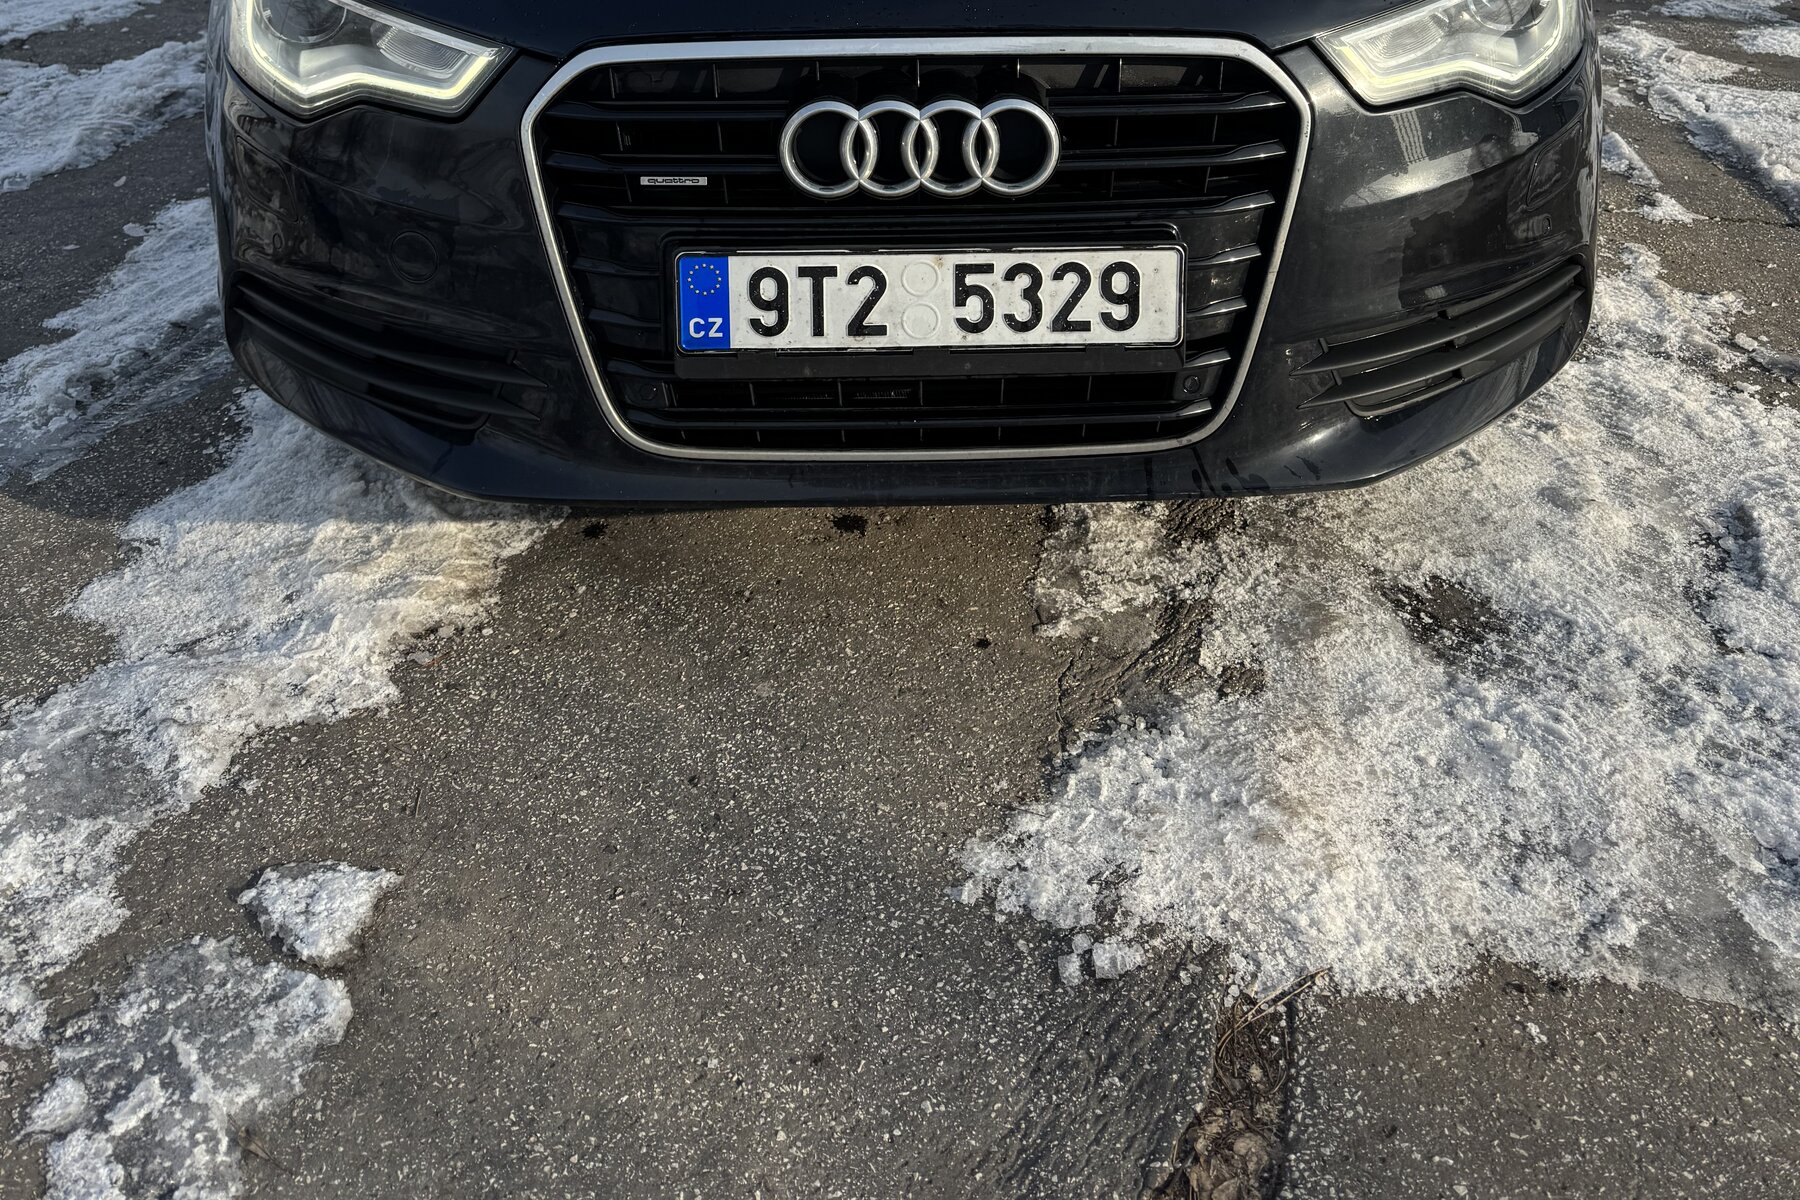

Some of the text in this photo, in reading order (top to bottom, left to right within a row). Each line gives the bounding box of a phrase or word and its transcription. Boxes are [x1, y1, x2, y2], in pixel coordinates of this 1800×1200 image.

[647, 177, 700, 185] quattro
[749, 261, 1141, 338] 9T2 5329
[688, 317, 724, 338] CZ
